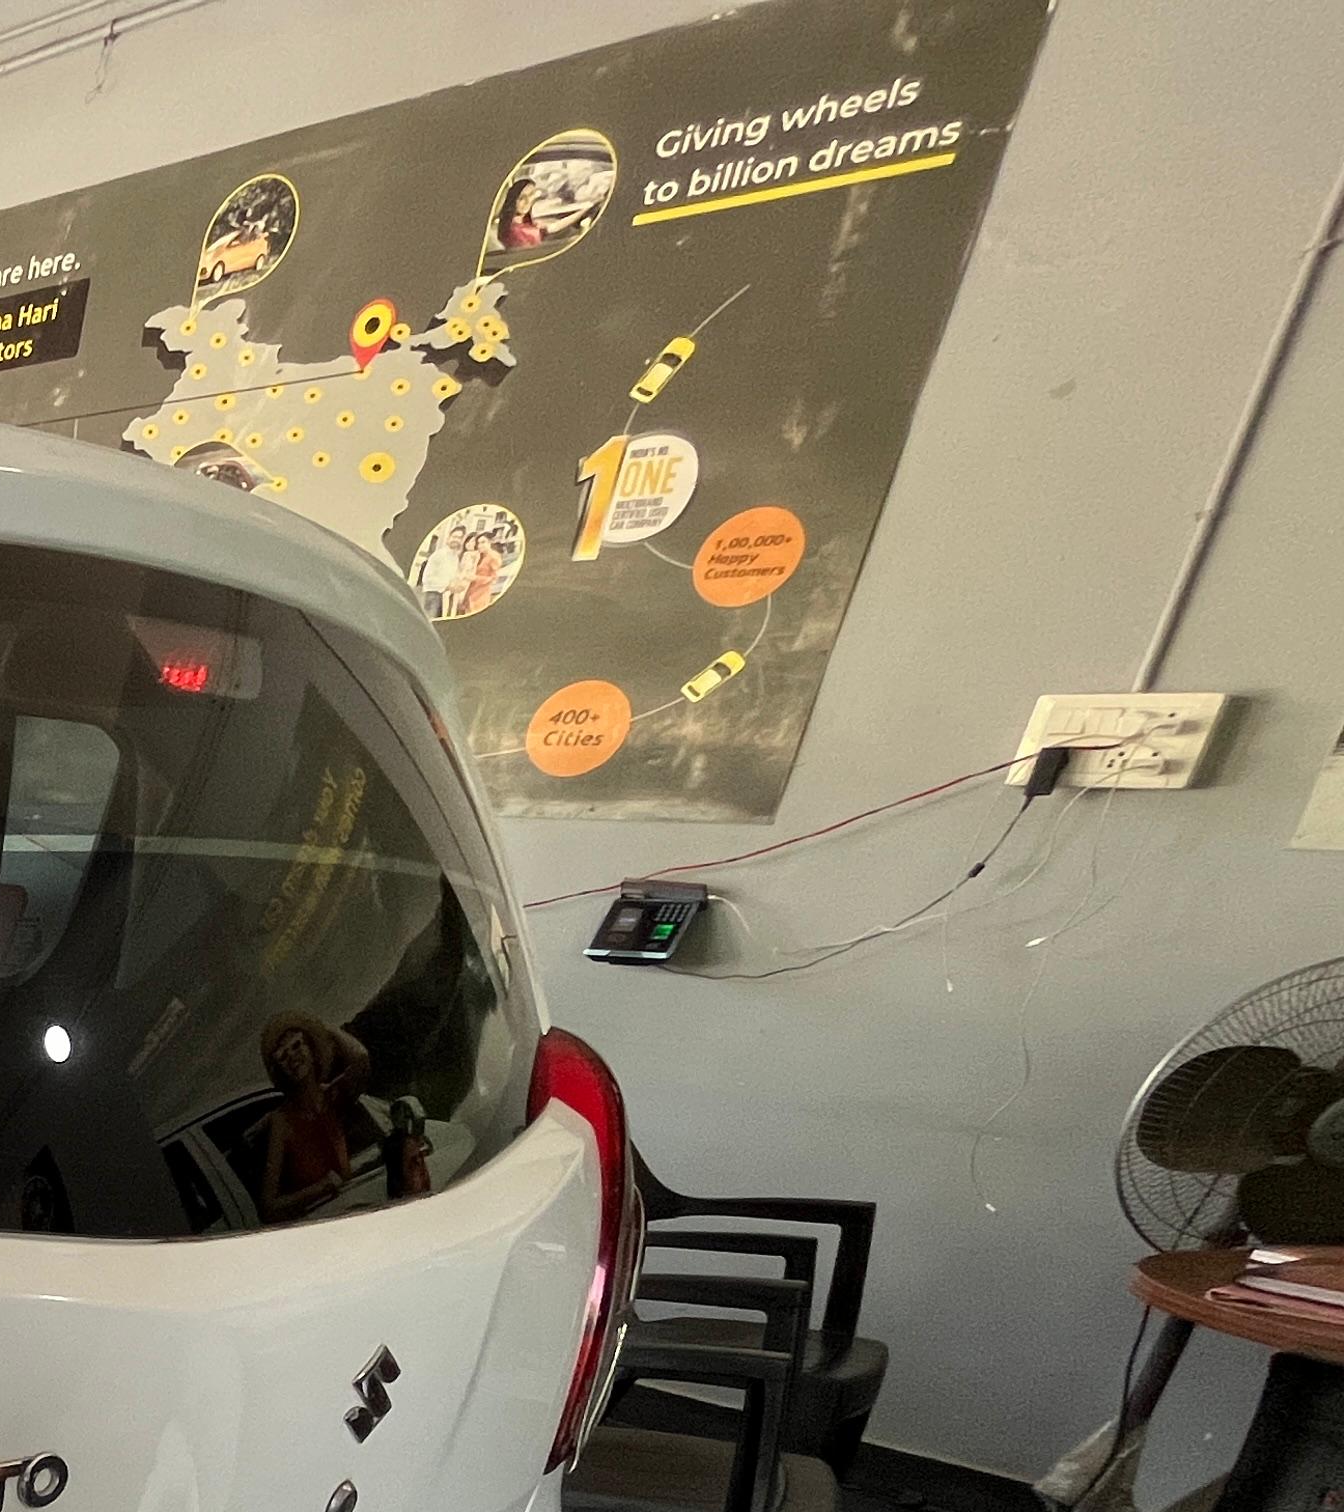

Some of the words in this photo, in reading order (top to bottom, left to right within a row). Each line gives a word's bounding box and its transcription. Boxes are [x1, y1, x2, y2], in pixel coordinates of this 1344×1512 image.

[655, 113, 772, 159] Giving
[780, 76, 921, 133] wheels
[643, 178, 680, 206] to
[686, 155, 800, 199] billion
[808, 120, 963, 173] dreams
[27, 252, 81, 281] here.
[17, 297, 60, 328] Hari
[619, 457, 683, 498] ONE
[703, 566, 786, 581] Customers
[707, 553, 760, 566] Happy
[548, 708, 601, 726] 400+
[542, 729, 606, 747] Cities
